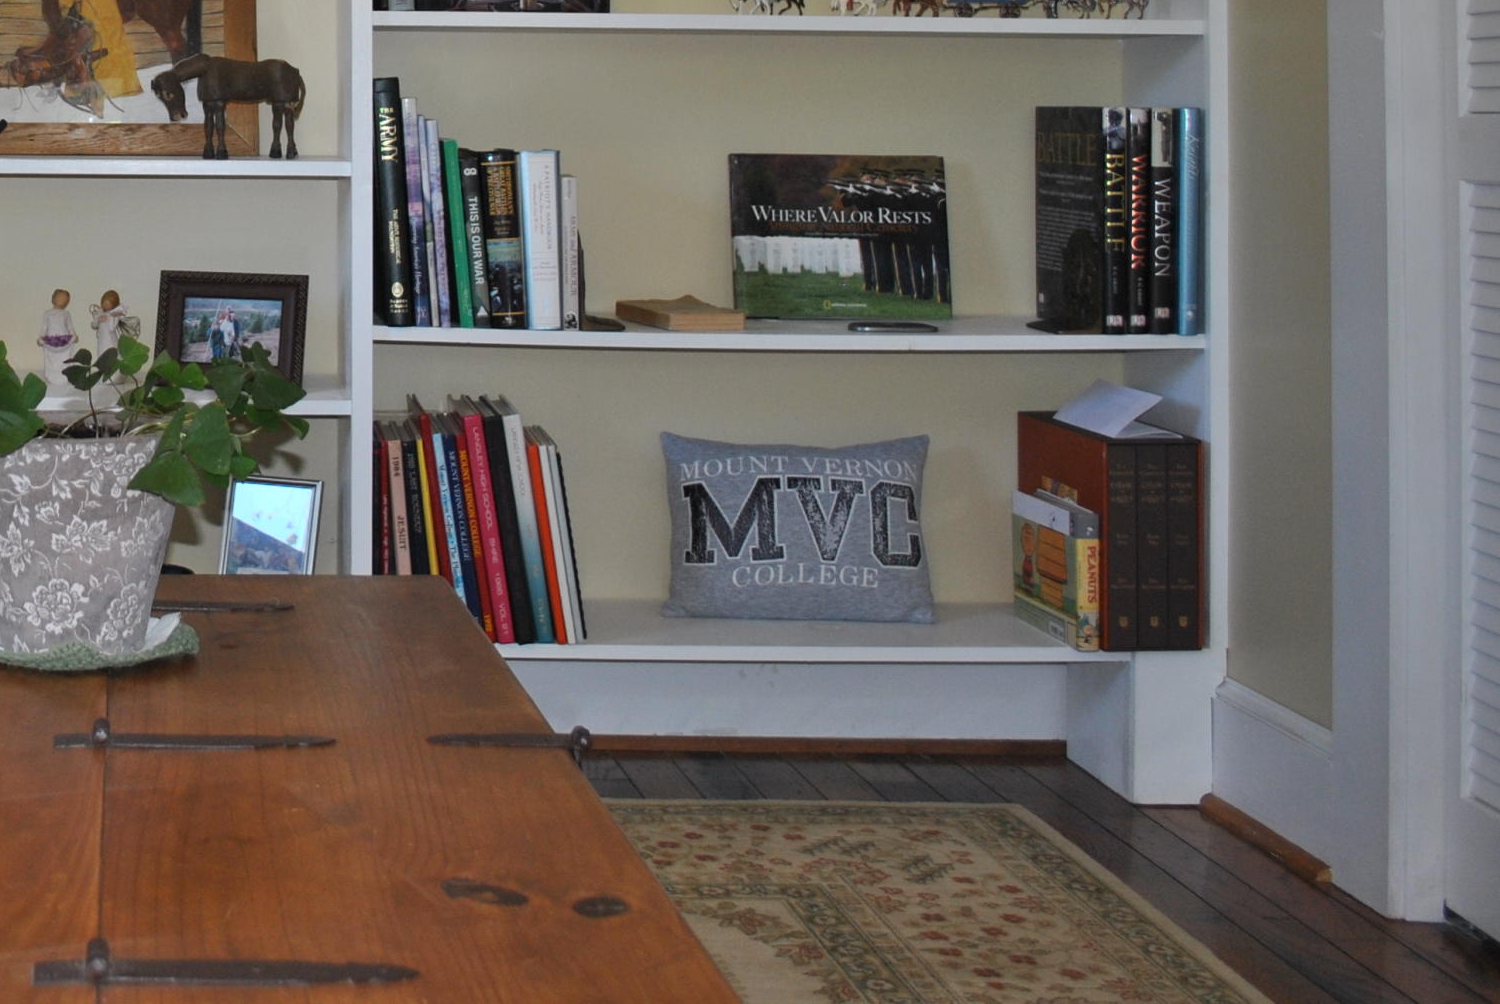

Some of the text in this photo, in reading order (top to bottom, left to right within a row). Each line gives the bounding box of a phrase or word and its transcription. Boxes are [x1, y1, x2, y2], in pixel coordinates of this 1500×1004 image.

[380, 115, 399, 164] ARMY
[468, 196, 485, 284] THIS IS OUR WAR
[543, 172, 553, 250] PATRIOT'S HANDBOOK
[750, 204, 932, 226] WHERE VALOR RESTS
[1104, 152, 1125, 253] BATTLE
[1130, 154, 1148, 270] WARRIOR
[1154, 177, 1172, 278] WEAPON
[570, 255, 579, 296] ARMOUR
[393, 455, 406, 551] 1984 JESUIT
[410, 493, 421, 533] ROUNDUP
[439, 464, 458, 560] Mount Vernon The
[448, 450, 470, 562] MOUNT VERNON COLLEGE
[459, 448, 481, 557] MOUNT VERNON COLLEGE
[472, 426, 494, 532] LANGLEY HIGH SCHOOL
[680, 455, 920, 483] MOUNT VERNON
[680, 475, 924, 569] MVC
[731, 563, 880, 590] COLLEGE
[1085, 545, 1100, 605] PEANUTS
